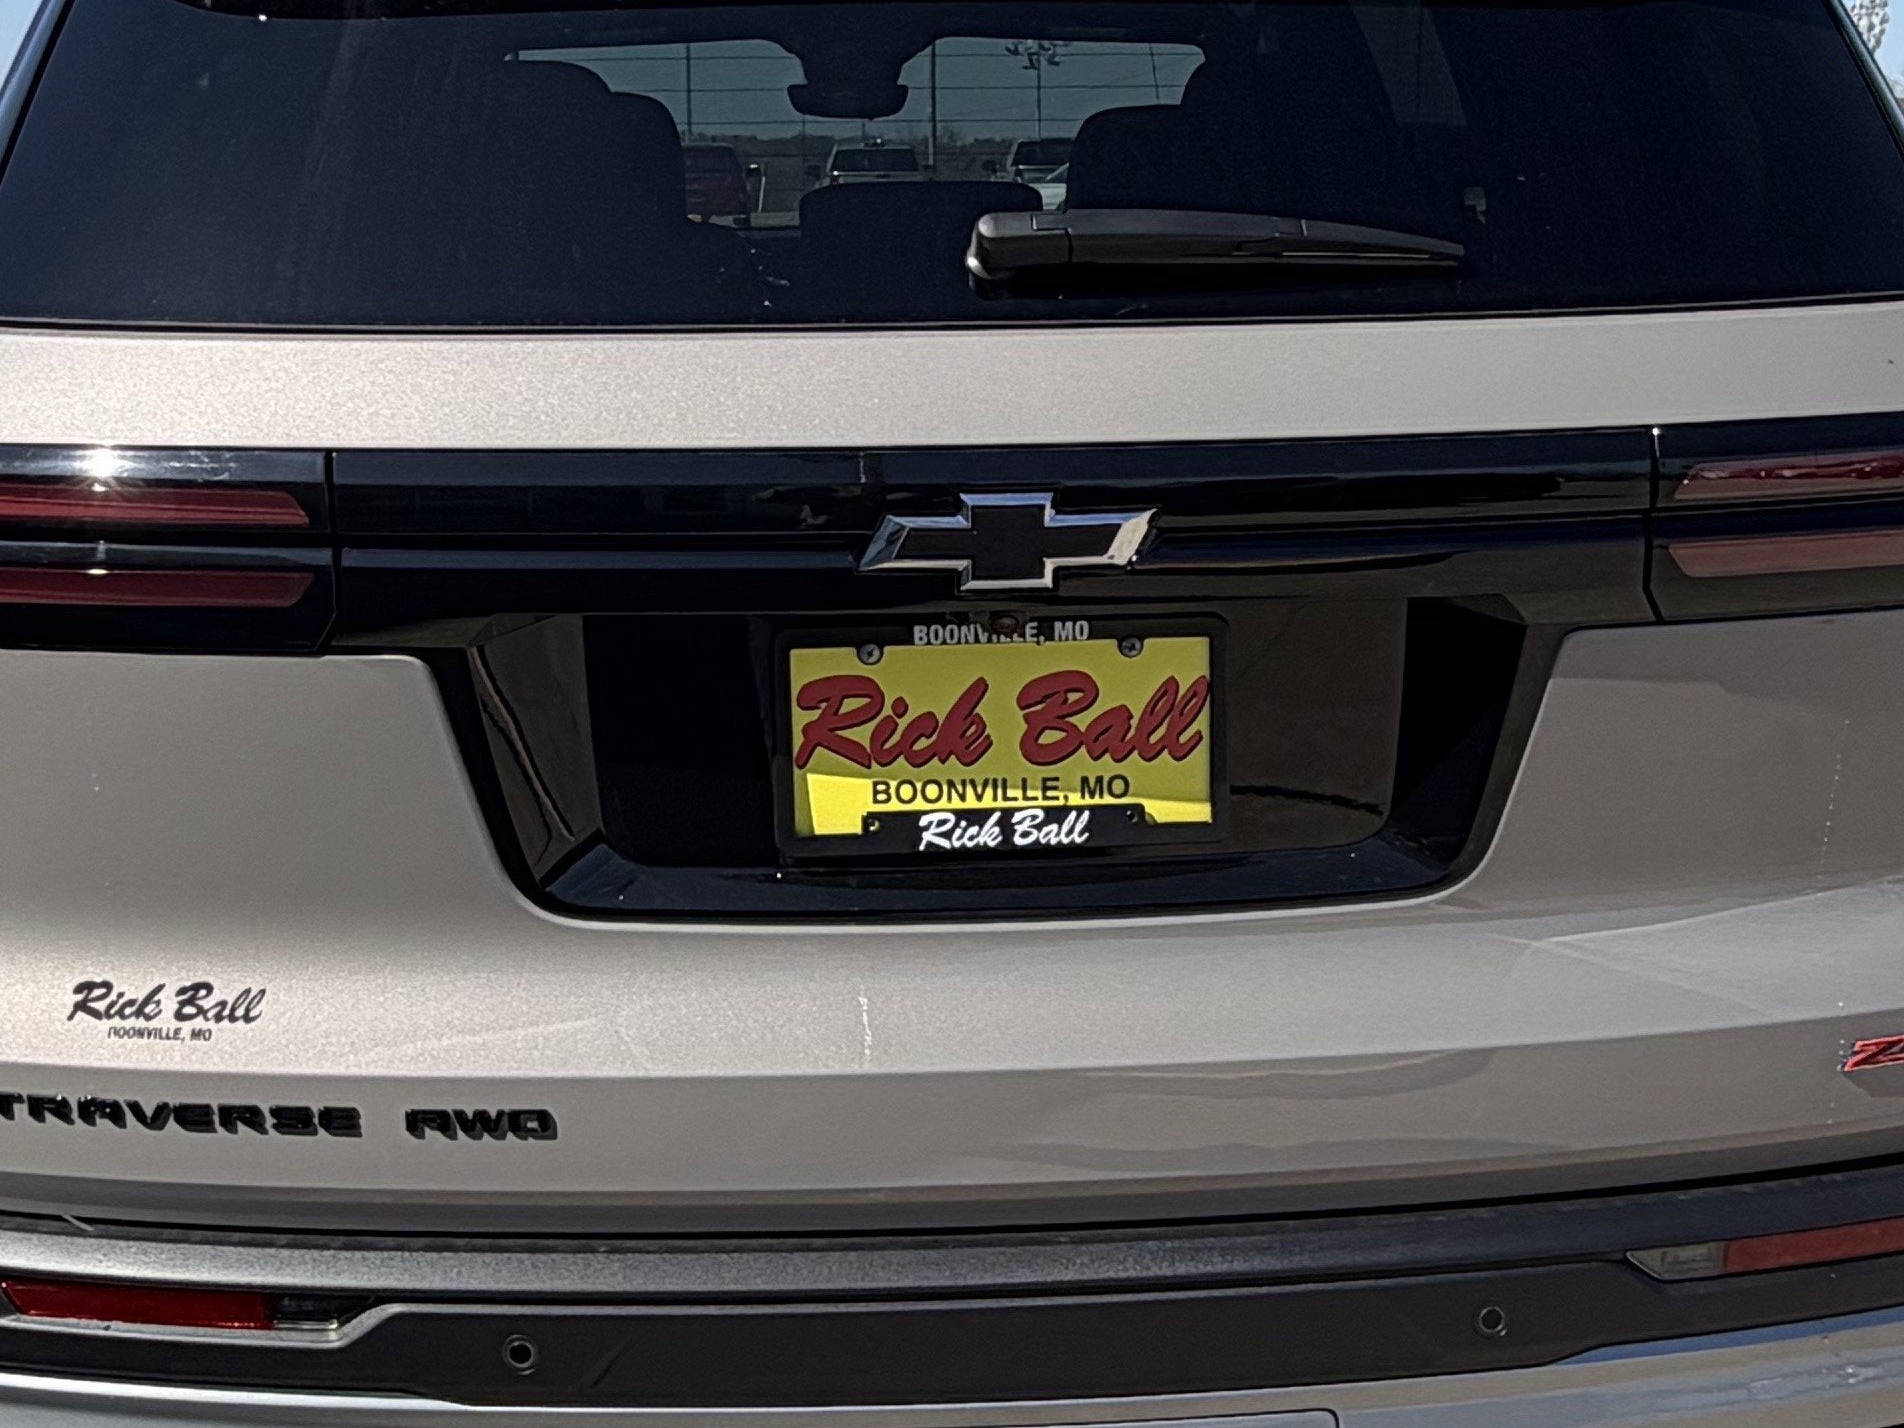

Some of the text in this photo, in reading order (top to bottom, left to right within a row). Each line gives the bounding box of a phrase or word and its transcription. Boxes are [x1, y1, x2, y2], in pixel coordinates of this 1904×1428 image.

[1054, 619, 1090, 642] MO
[796, 669, 1210, 770] Rick Ball
[871, 773, 1131, 806] BOONVILLE, MO
[918, 809, 1092, 852] Rick Ball
[66, 979, 267, 1024] Rick Ball
[189, 1028, 213, 1042] MO
[404, 1107, 559, 1142] AWD
